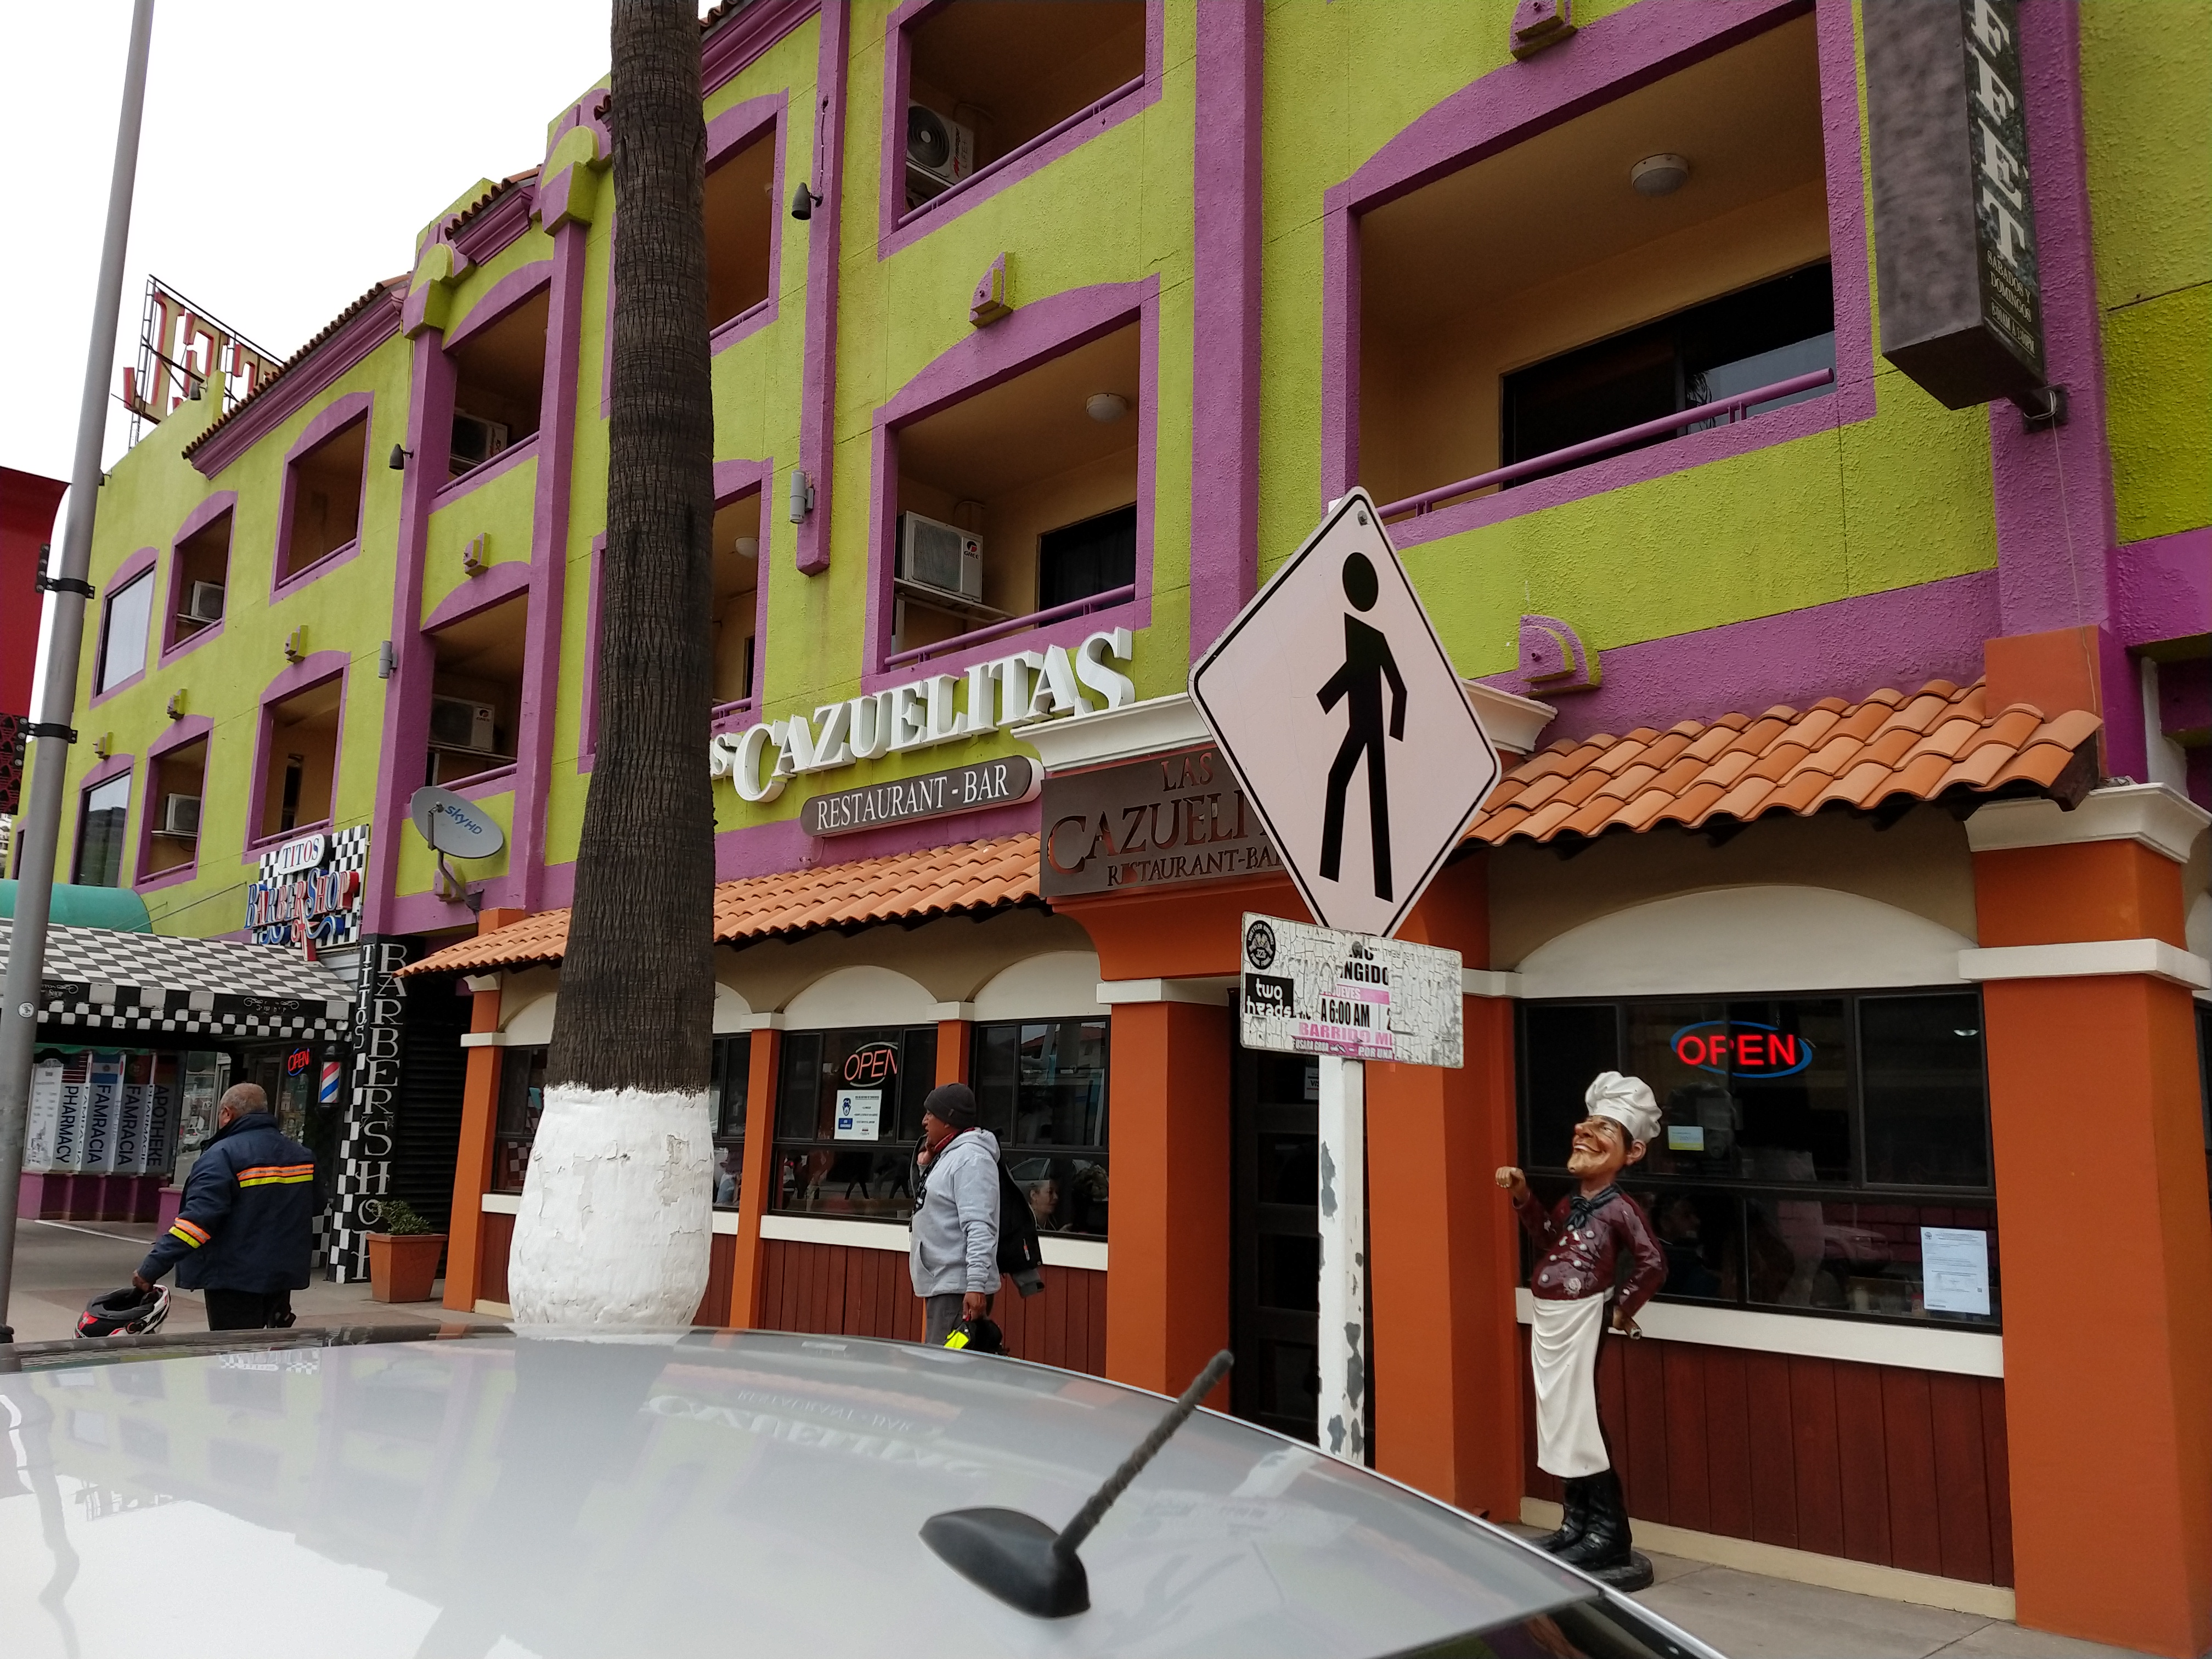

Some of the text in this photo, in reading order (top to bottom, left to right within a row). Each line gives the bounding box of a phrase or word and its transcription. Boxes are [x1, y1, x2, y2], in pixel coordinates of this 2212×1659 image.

[1987, 250, 2031, 304] SABADOS Y
[1990, 271, 2032, 323] DOMINGOS
[733, 627, 1135, 803] CAZUELITAS
[1160, 752, 1214, 792] LAS
[816, 775, 948, 831] RESTAURANT
[964, 764, 1009, 804] BAR
[464, 821, 483, 835] HD
[1047, 789, 1267, 874] CAZUELI
[283, 838, 320, 869] TITOS
[352, 943, 376, 1049] TITOS
[1246, 995, 1292, 1018] heads
[1256, 978, 1283, 1001] two
[1299, 1022, 1371, 1043] BARRIDO
[1321, 998, 1327, 1023] A
[1329, 1000, 1351, 1026] 6:00
[1353, 1004, 1370, 1028] AM
[288, 1050, 310, 1072] OPEN
[844, 1048, 898, 1081] OPEN
[1676, 1034, 1797, 1066] OPEN
[55, 1086, 79, 1164] PHARMACY
[87, 1085, 112, 1164] FAMRACIA
[117, 1086, 142, 1166] FAMRACIA
[147, 1085, 170, 1166] APOTHEKE
